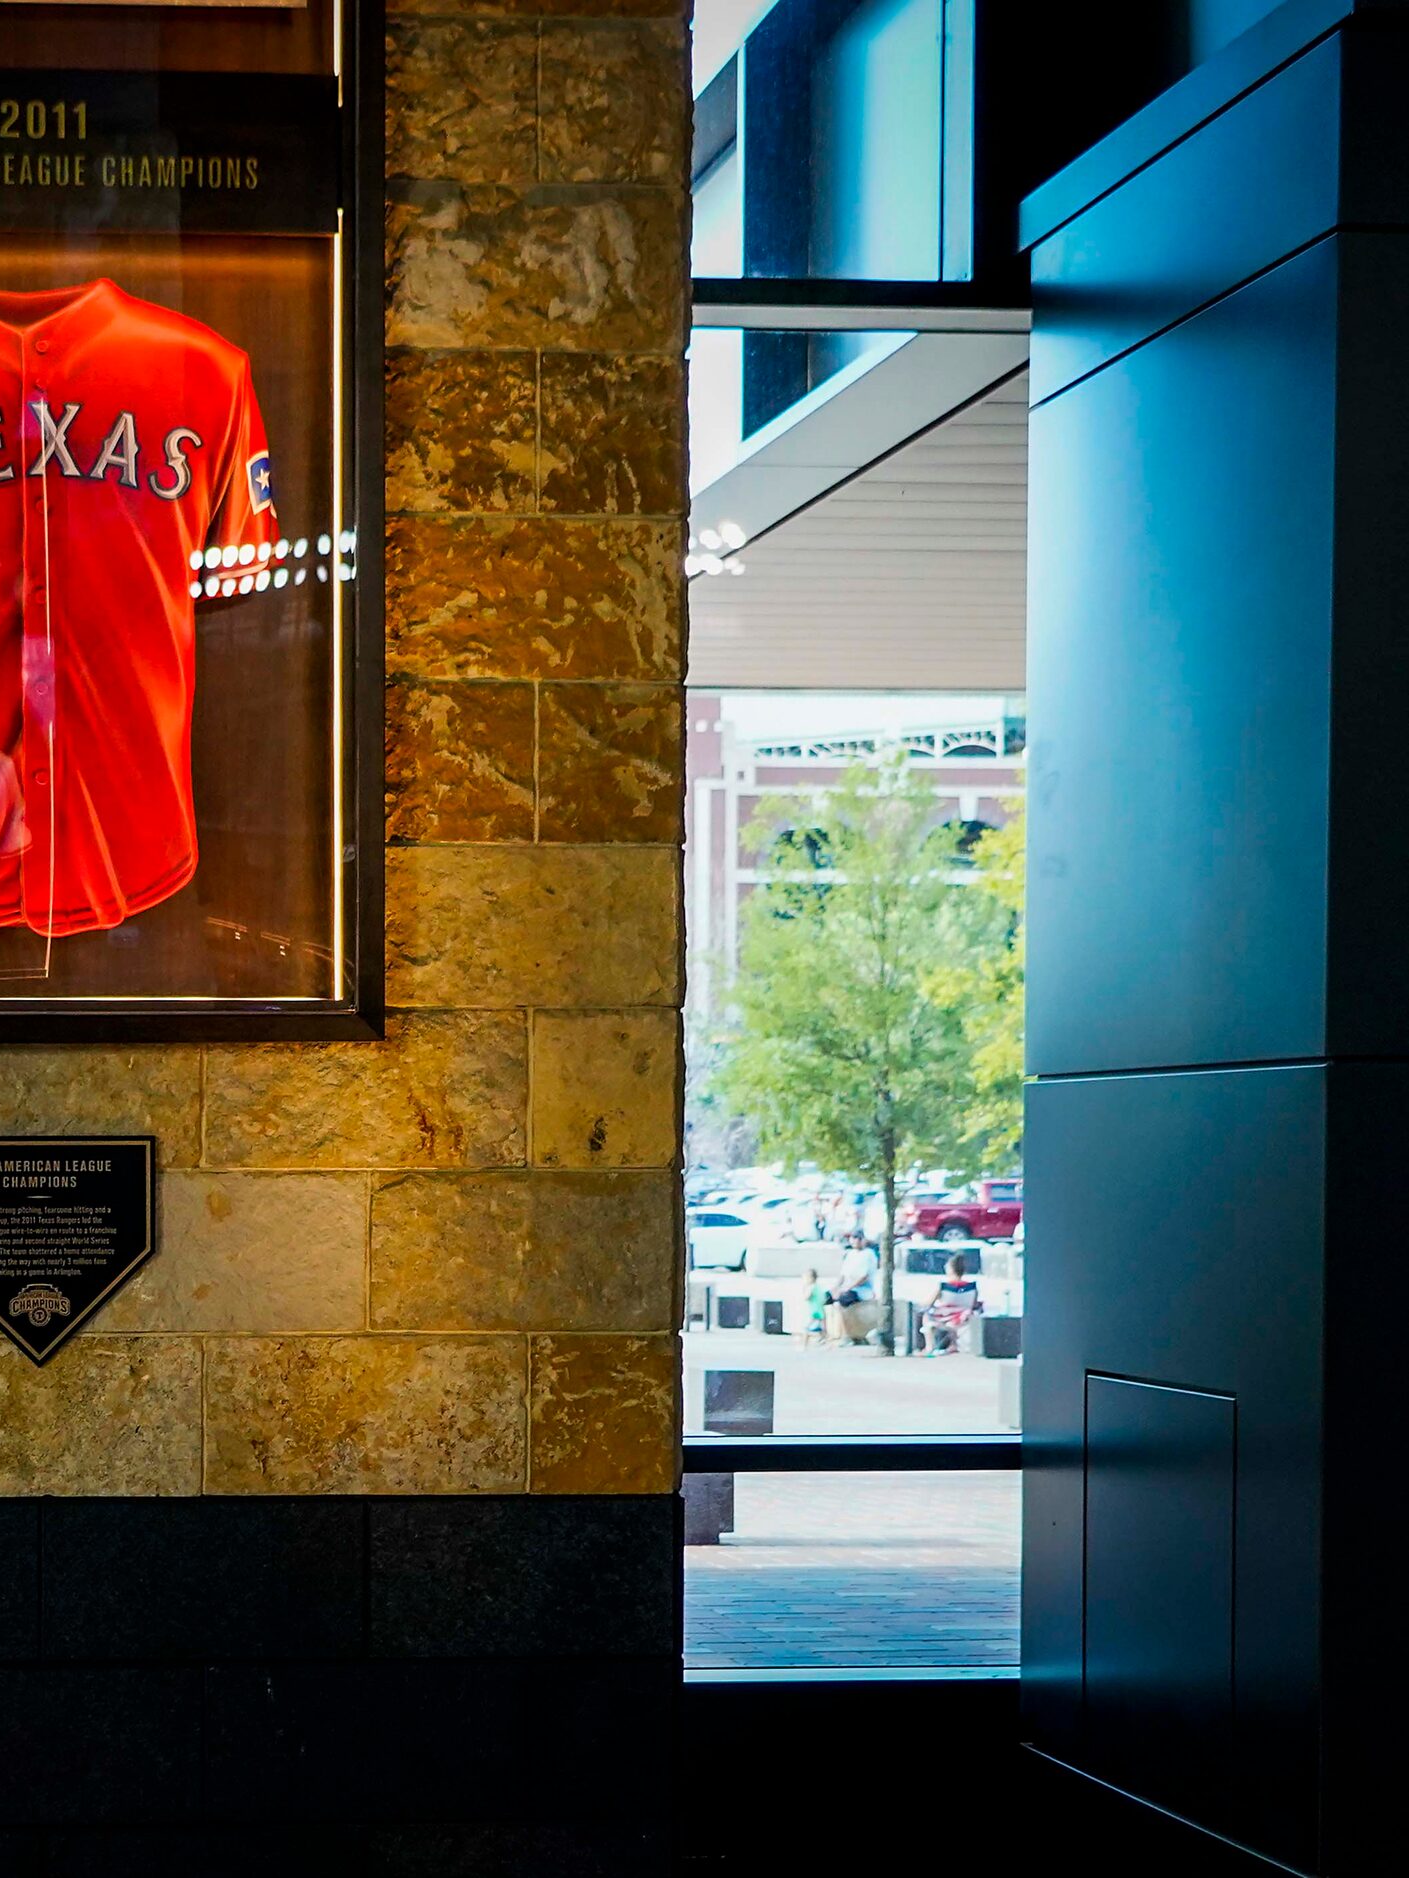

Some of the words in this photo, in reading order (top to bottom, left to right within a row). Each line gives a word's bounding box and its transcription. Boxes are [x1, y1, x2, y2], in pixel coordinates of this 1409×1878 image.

[0, 99, 88, 140] 2011
[102, 156, 259, 190] CHAMPIONS
[64, 1160, 112, 1172] LEAGUE
[2, 1176, 77, 1188] CHAMPIONS
[21, 1216, 36, 1224] 2011
[12, 1299, 67, 1313] CHAMPIONS
